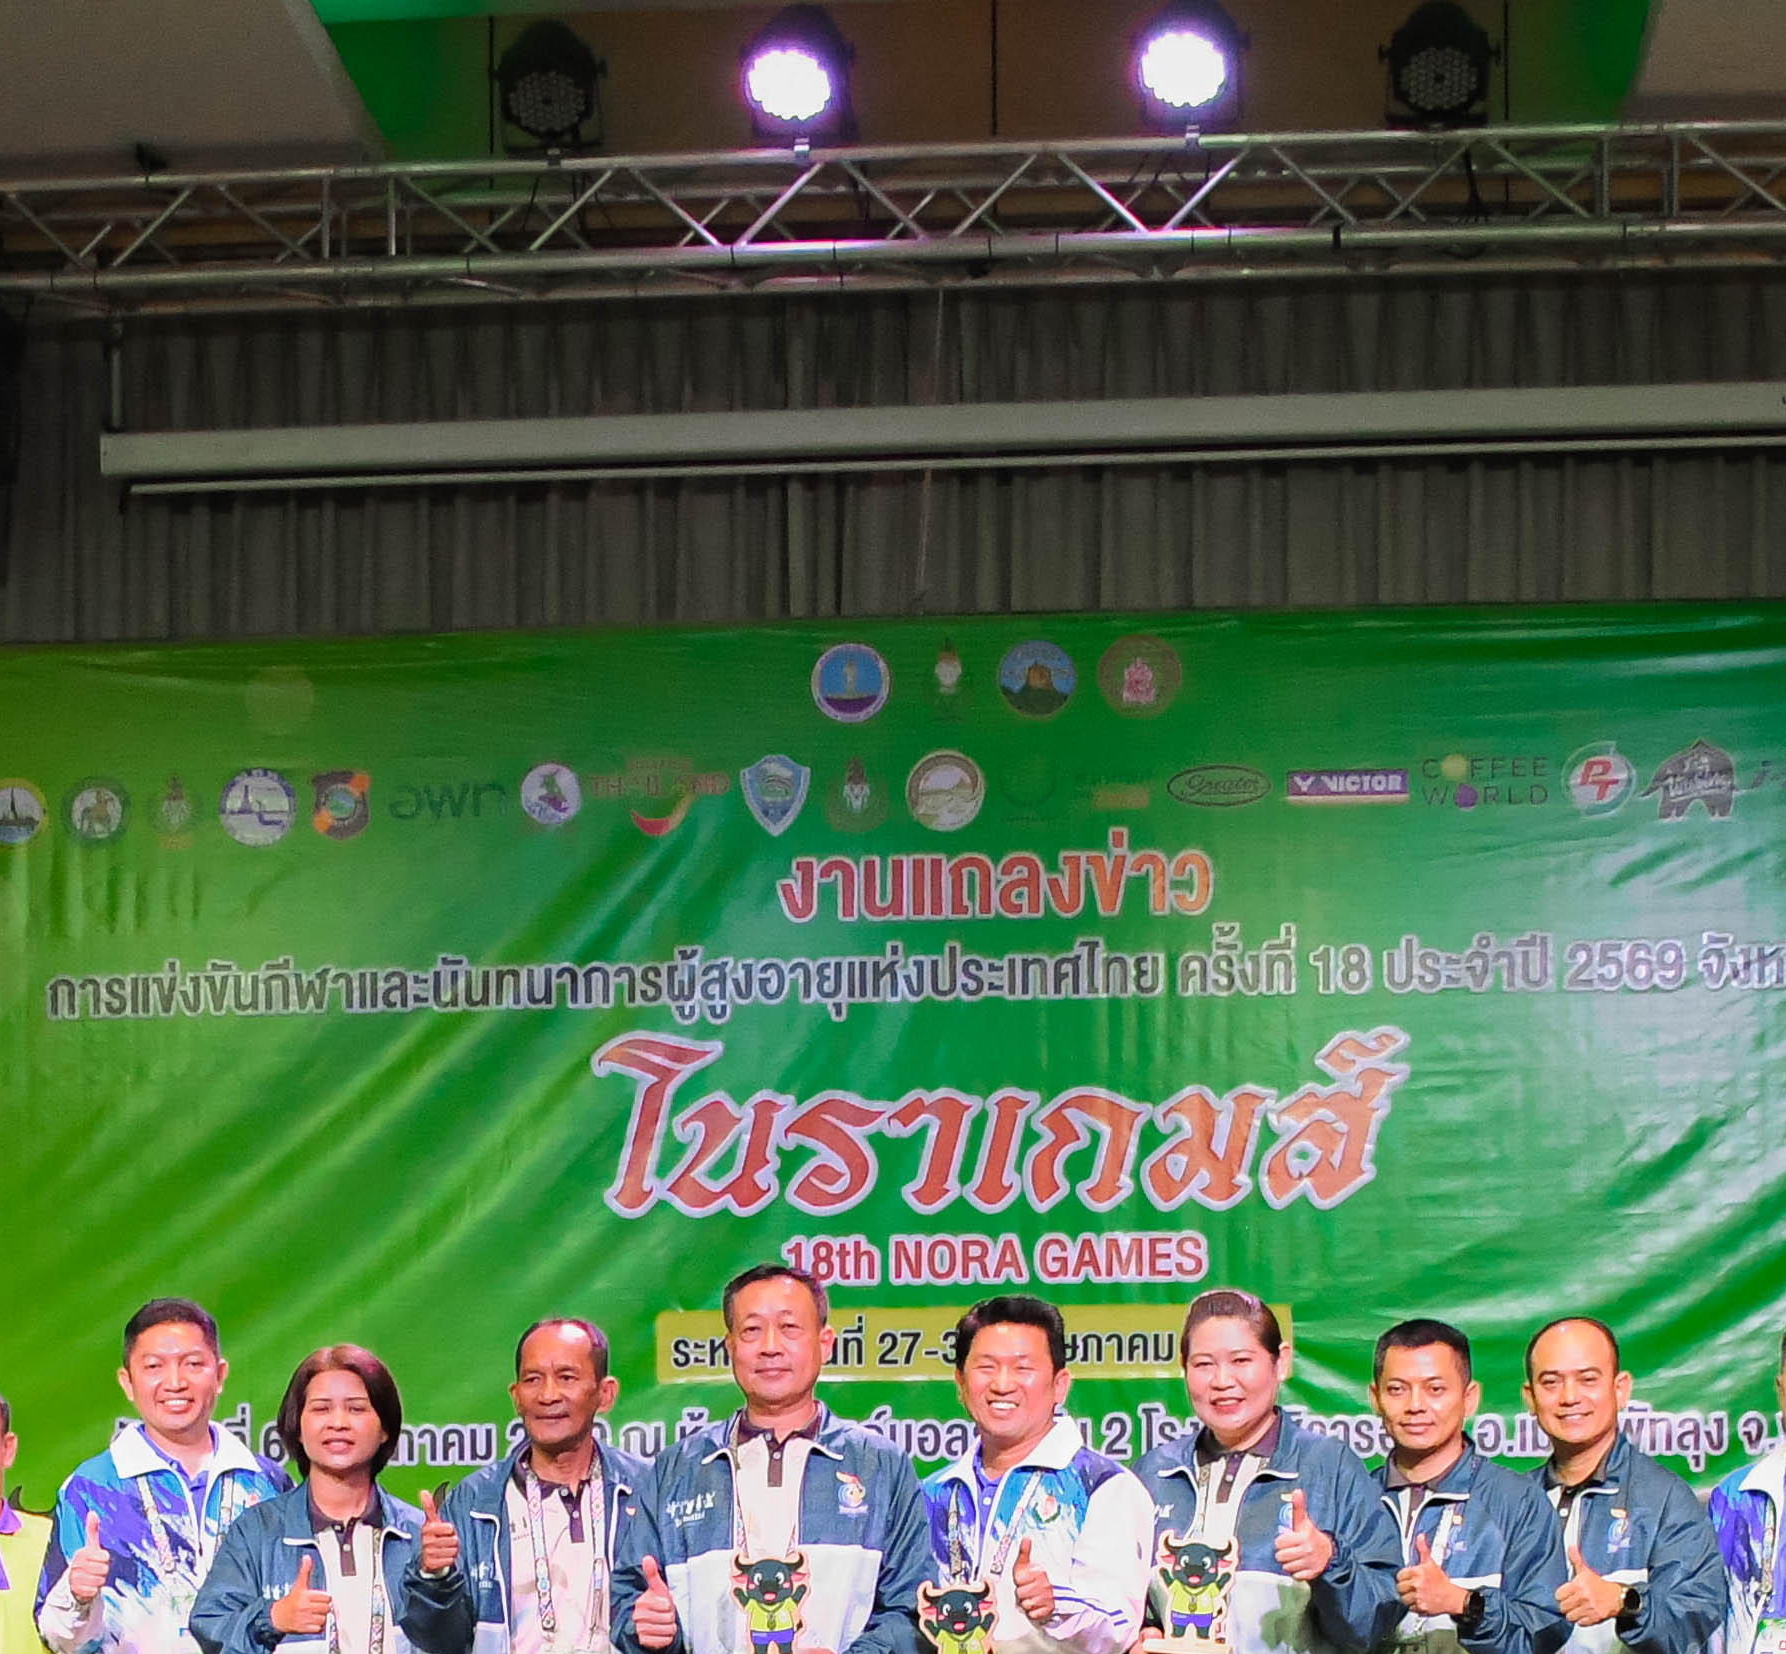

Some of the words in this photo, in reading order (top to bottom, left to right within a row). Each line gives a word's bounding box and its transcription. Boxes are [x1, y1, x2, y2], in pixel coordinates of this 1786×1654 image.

[1321, 774, 1403, 793] VICTOR
[779, 827, 1215, 922] งานแถลงข่าว
[1176, 922, 1296, 998] ครั้งที่
[1308, 944, 1375, 995] 18
[1382, 931, 1554, 995] ประจำปี
[1562, 939, 1688, 991] 2569
[590, 1024, 1411, 1219] โนราเกมส์
[781, 1236, 884, 1284] 18th
[890, 1235, 1026, 1284] NORA
[1035, 1233, 1208, 1283] GAMES
[1104, 1416, 1129, 1456] 2
